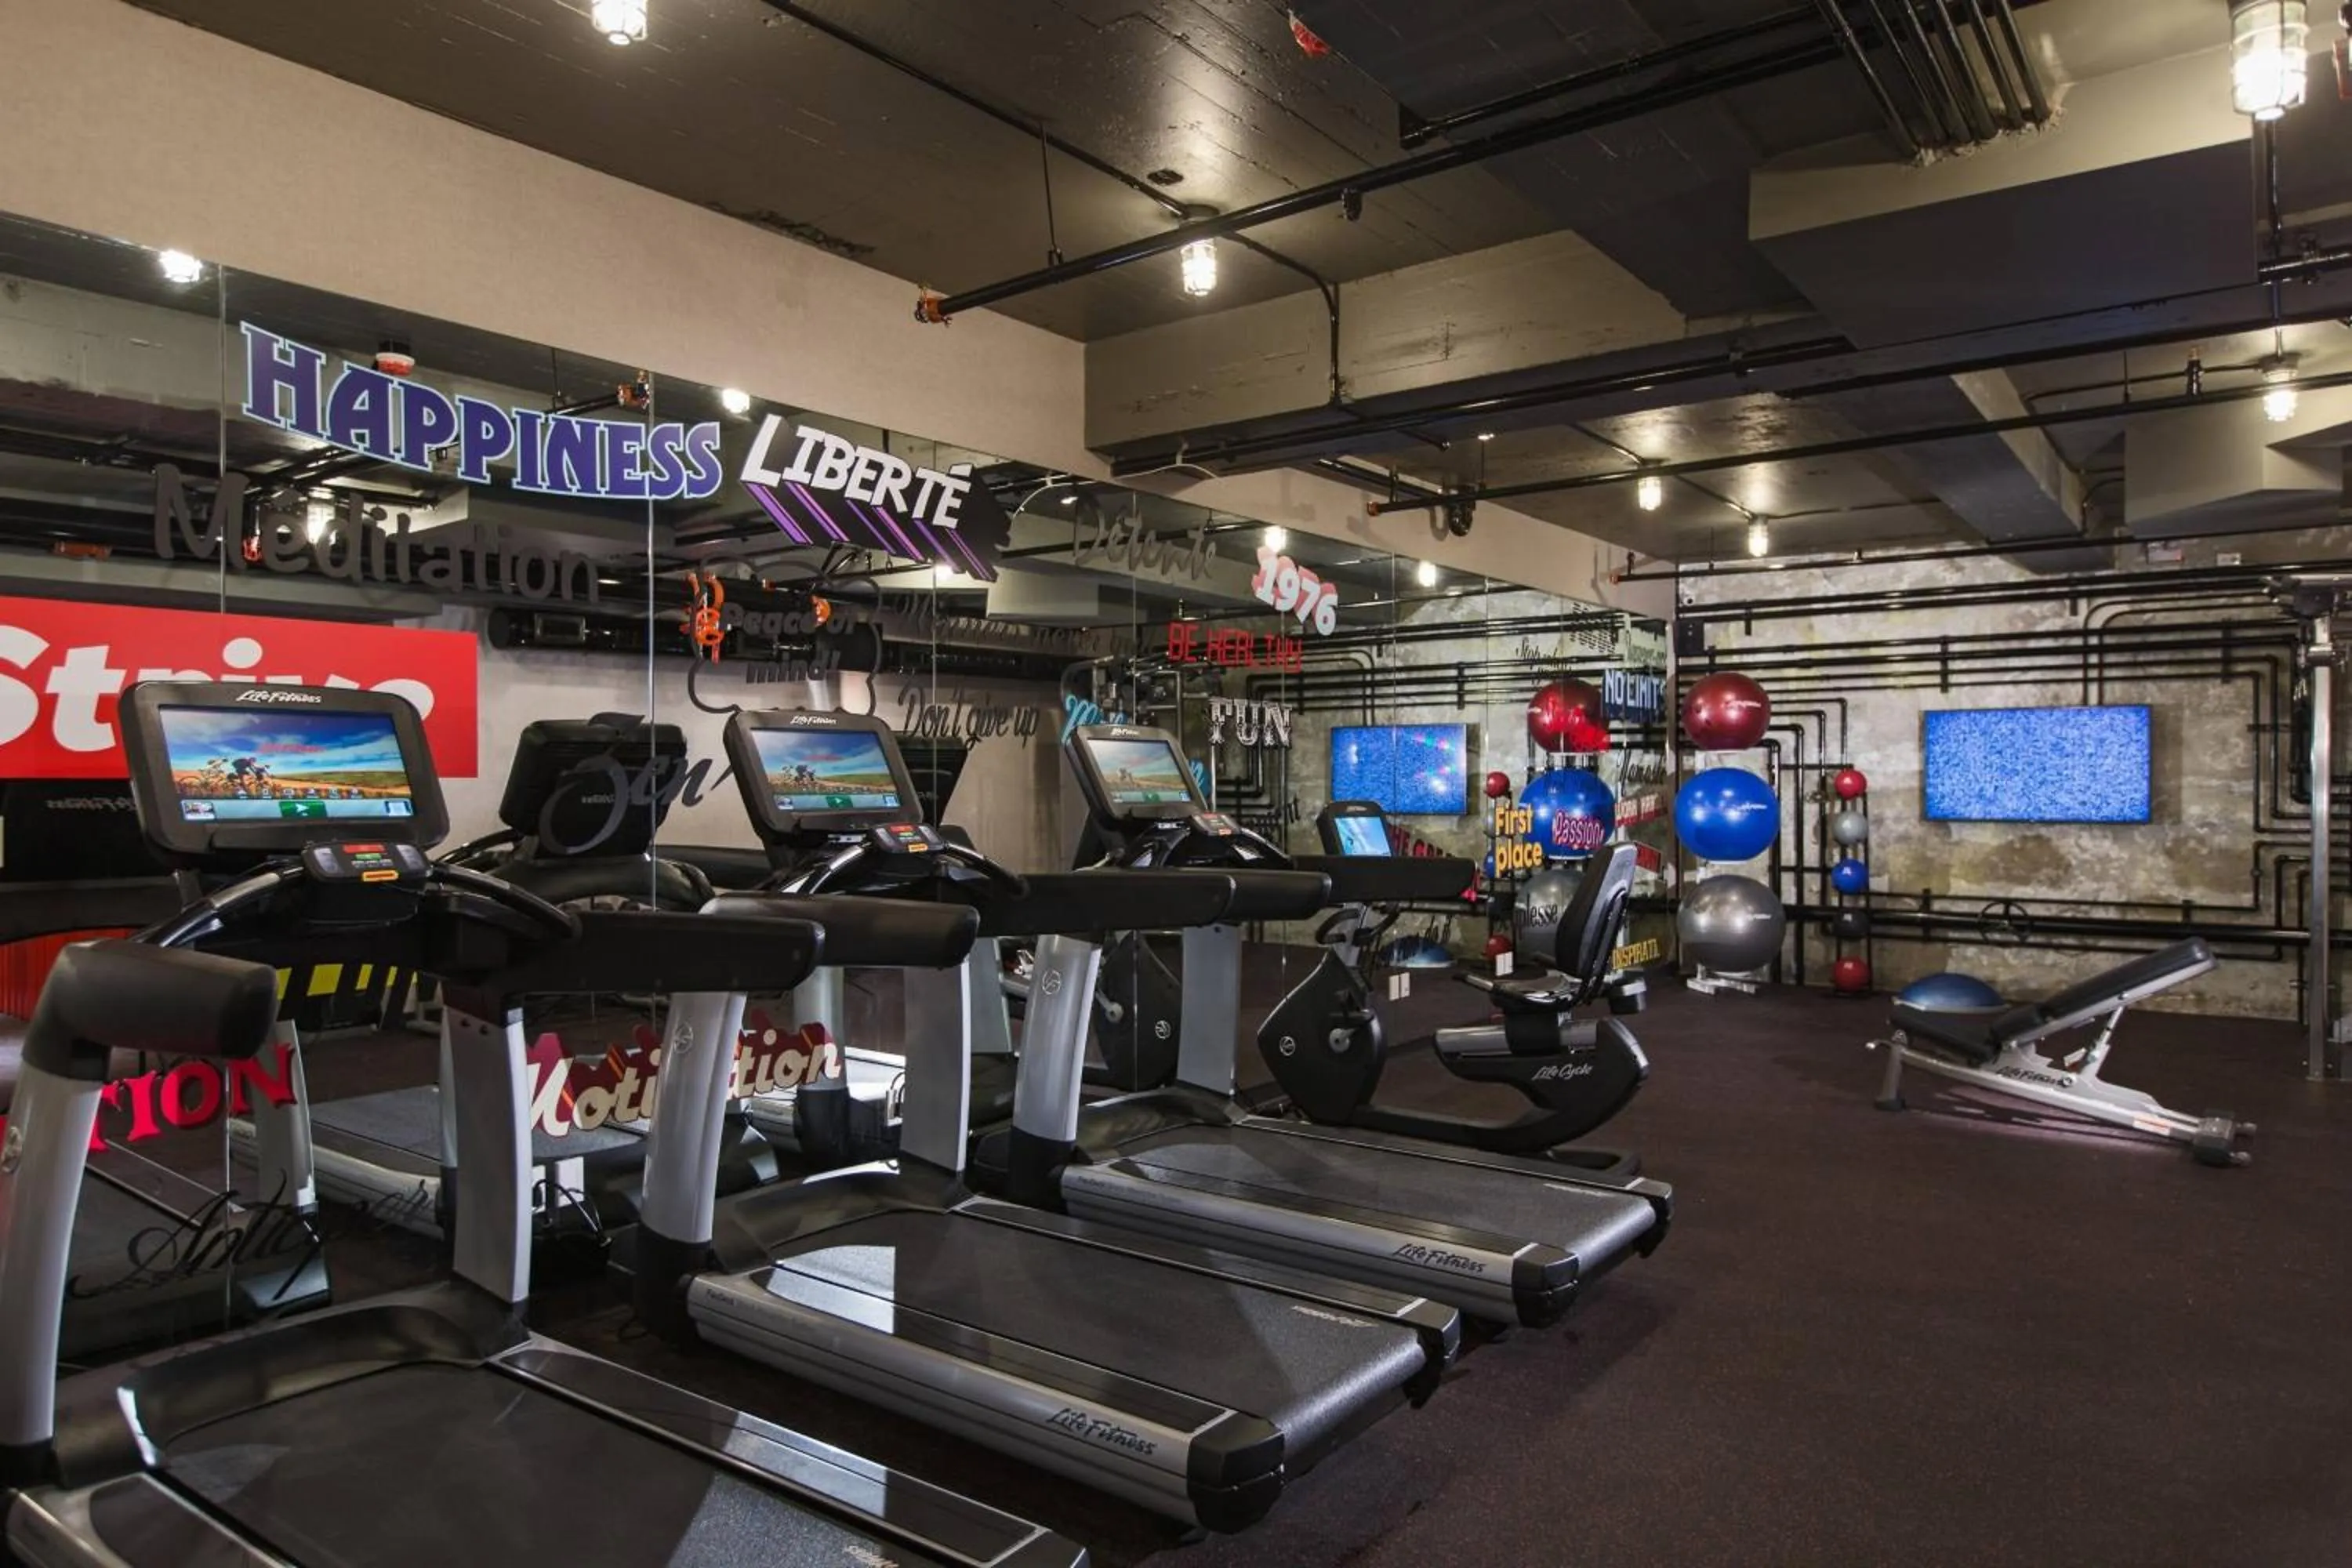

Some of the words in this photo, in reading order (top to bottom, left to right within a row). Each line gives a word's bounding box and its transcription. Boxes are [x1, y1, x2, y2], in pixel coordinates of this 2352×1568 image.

[240, 320, 723, 500] HAPPINESS
[740, 413, 973, 528] LIBERTÉ
[1254, 554, 1338, 637] 1976
[1167, 622, 1201, 663] BE
[1605, 668, 1624, 705] NO
[898, 679, 964, 739] Don't
[1012, 705, 1041, 749] up
[1208, 697, 1293, 749] FUN
[1495, 802, 1533, 836] First
[1552, 809, 1605, 848] Passion
[1495, 837, 1543, 879] place
[527, 1026, 841, 1138] Motition
